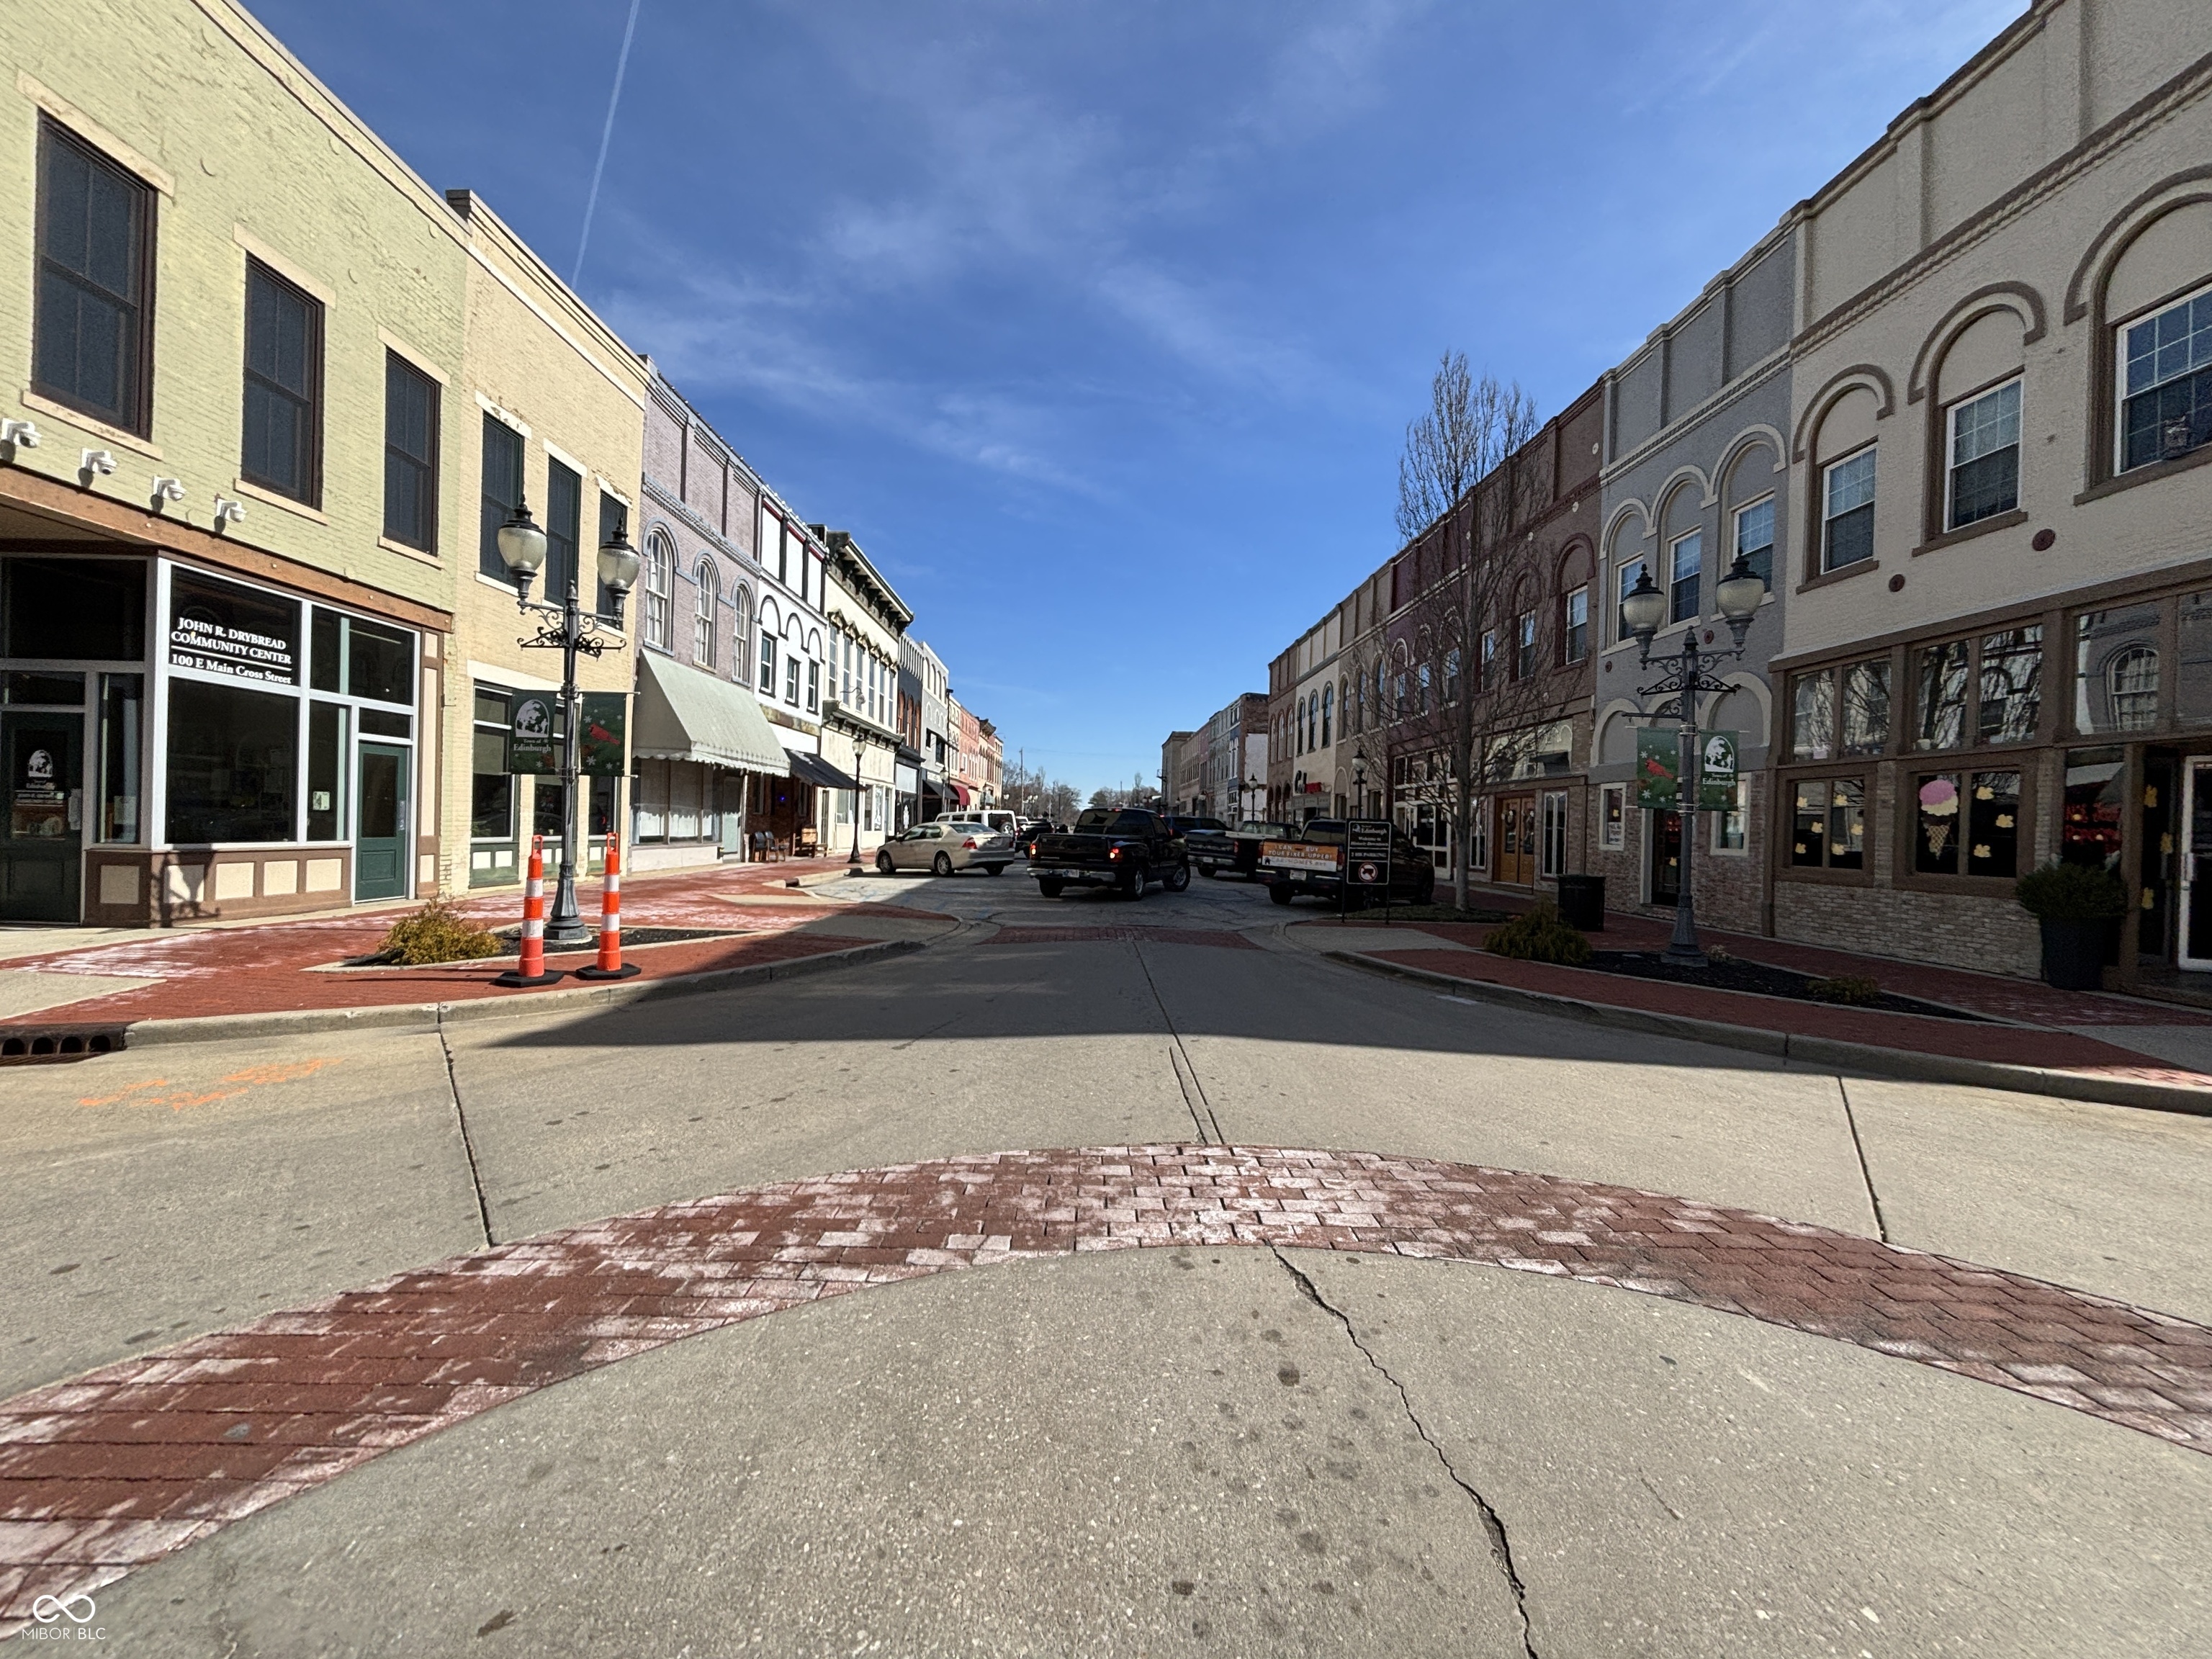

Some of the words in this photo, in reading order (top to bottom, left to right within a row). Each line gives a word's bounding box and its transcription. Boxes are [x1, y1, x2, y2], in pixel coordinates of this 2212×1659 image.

[171, 631, 249, 655] COMMUNITY
[249, 647, 292, 664] CENTER
[177, 617, 213, 634] JOHN
[215, 626, 227, 637] R.
[228, 629, 287, 649] DRYBREAD
[172, 654, 194, 666] 100
[195, 657, 204, 668] E
[206, 660, 234, 674] Main
[235, 665, 264, 679] Cross
[265, 671, 292, 684] Street
[514, 744, 552, 753] Edinburgh
[1702, 778, 1736, 788] Edinburgh
